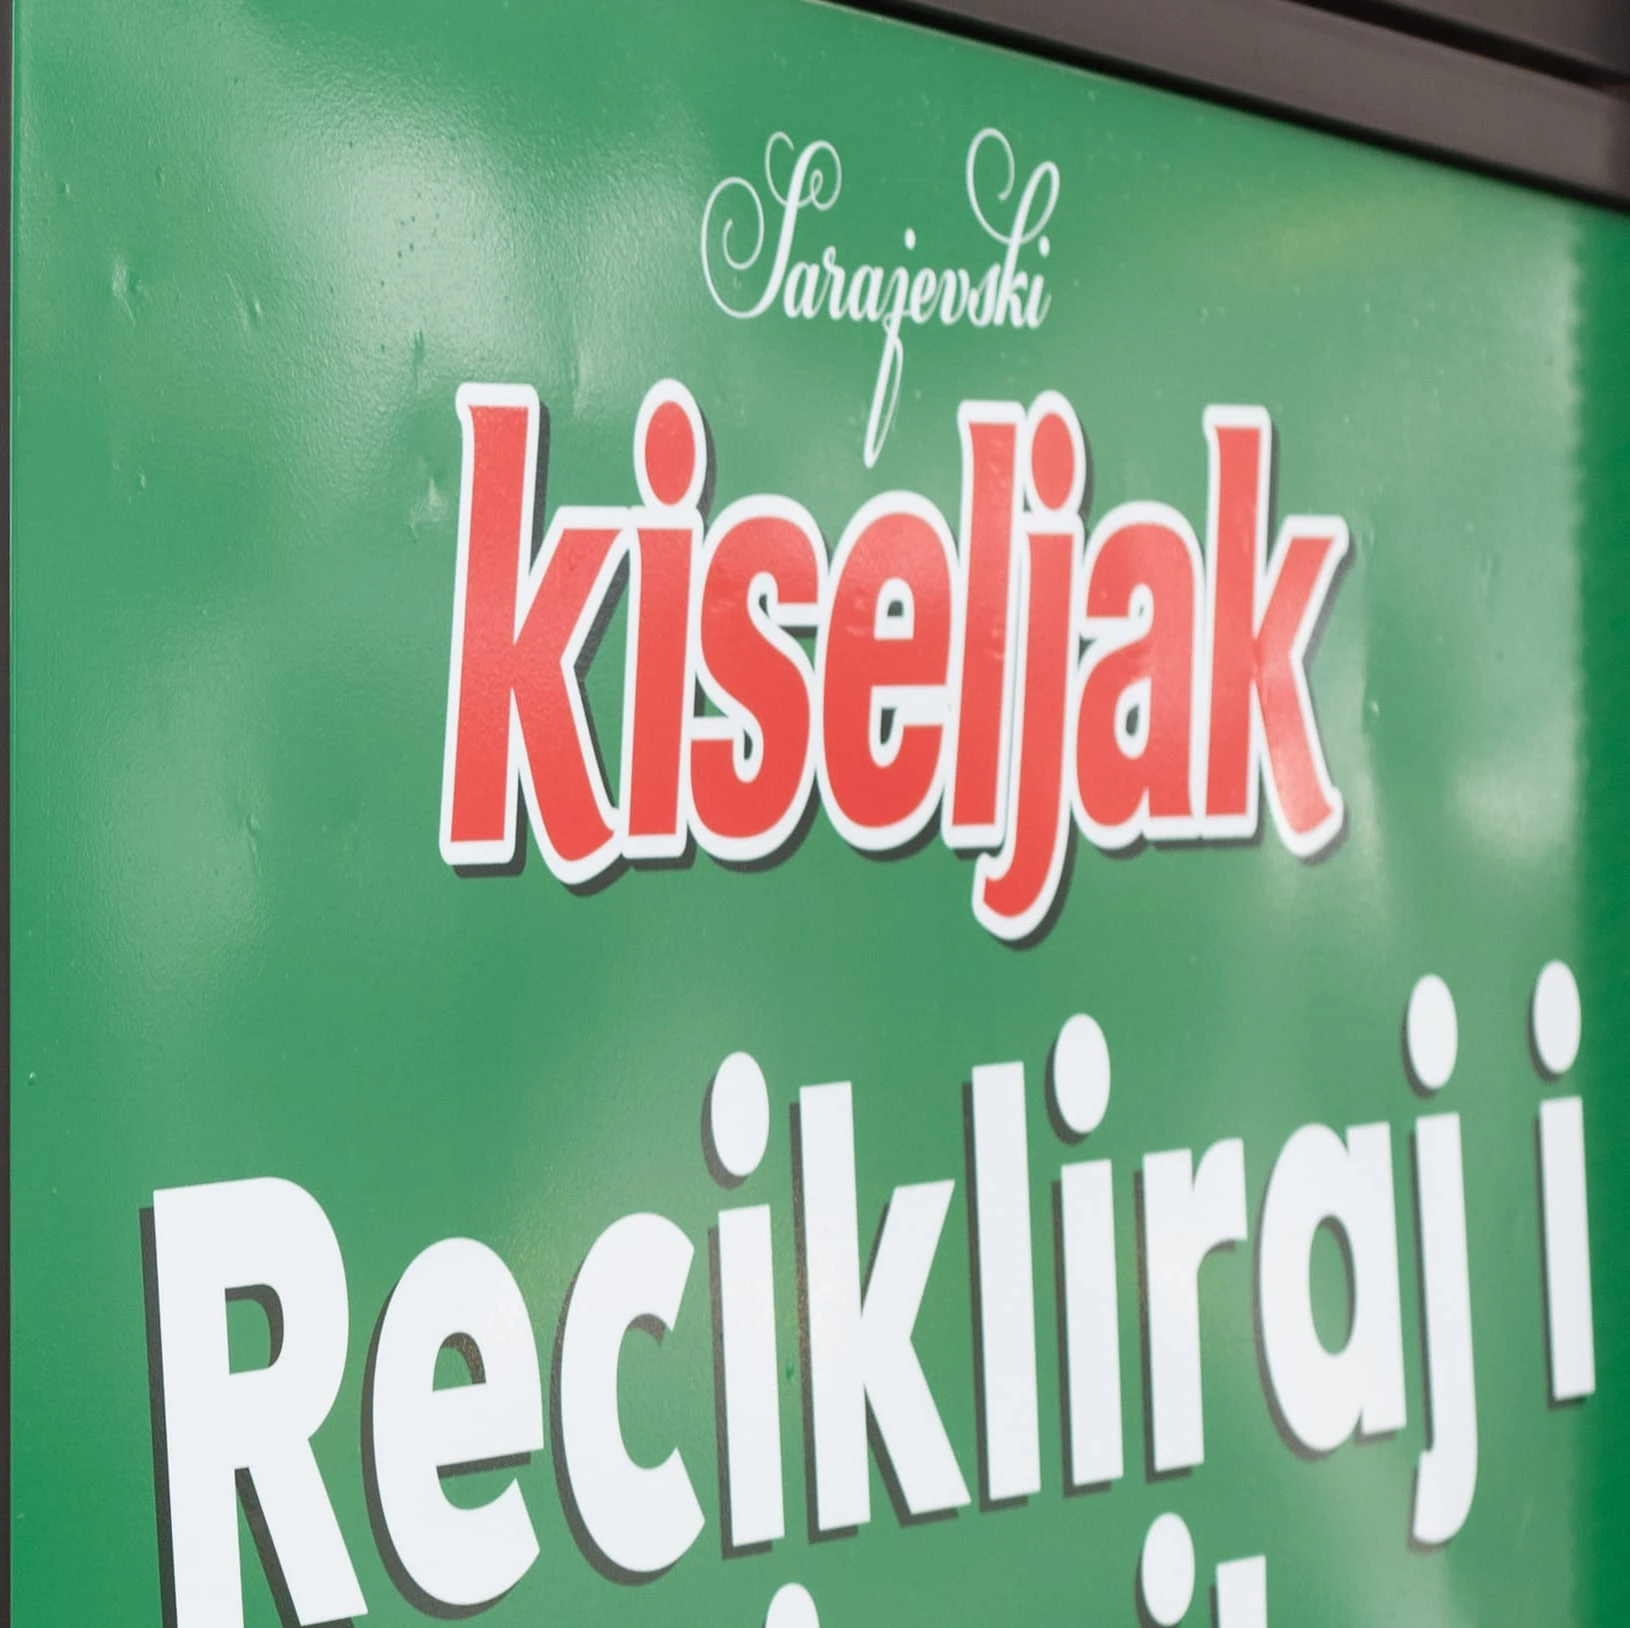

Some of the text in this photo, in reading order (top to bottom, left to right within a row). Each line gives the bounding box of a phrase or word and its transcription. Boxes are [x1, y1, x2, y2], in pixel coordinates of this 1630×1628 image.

[701, 127, 1061, 468] Sarajevski
[439, 378, 1350, 941] kiseljak
[1532, 960, 1597, 1398] i
